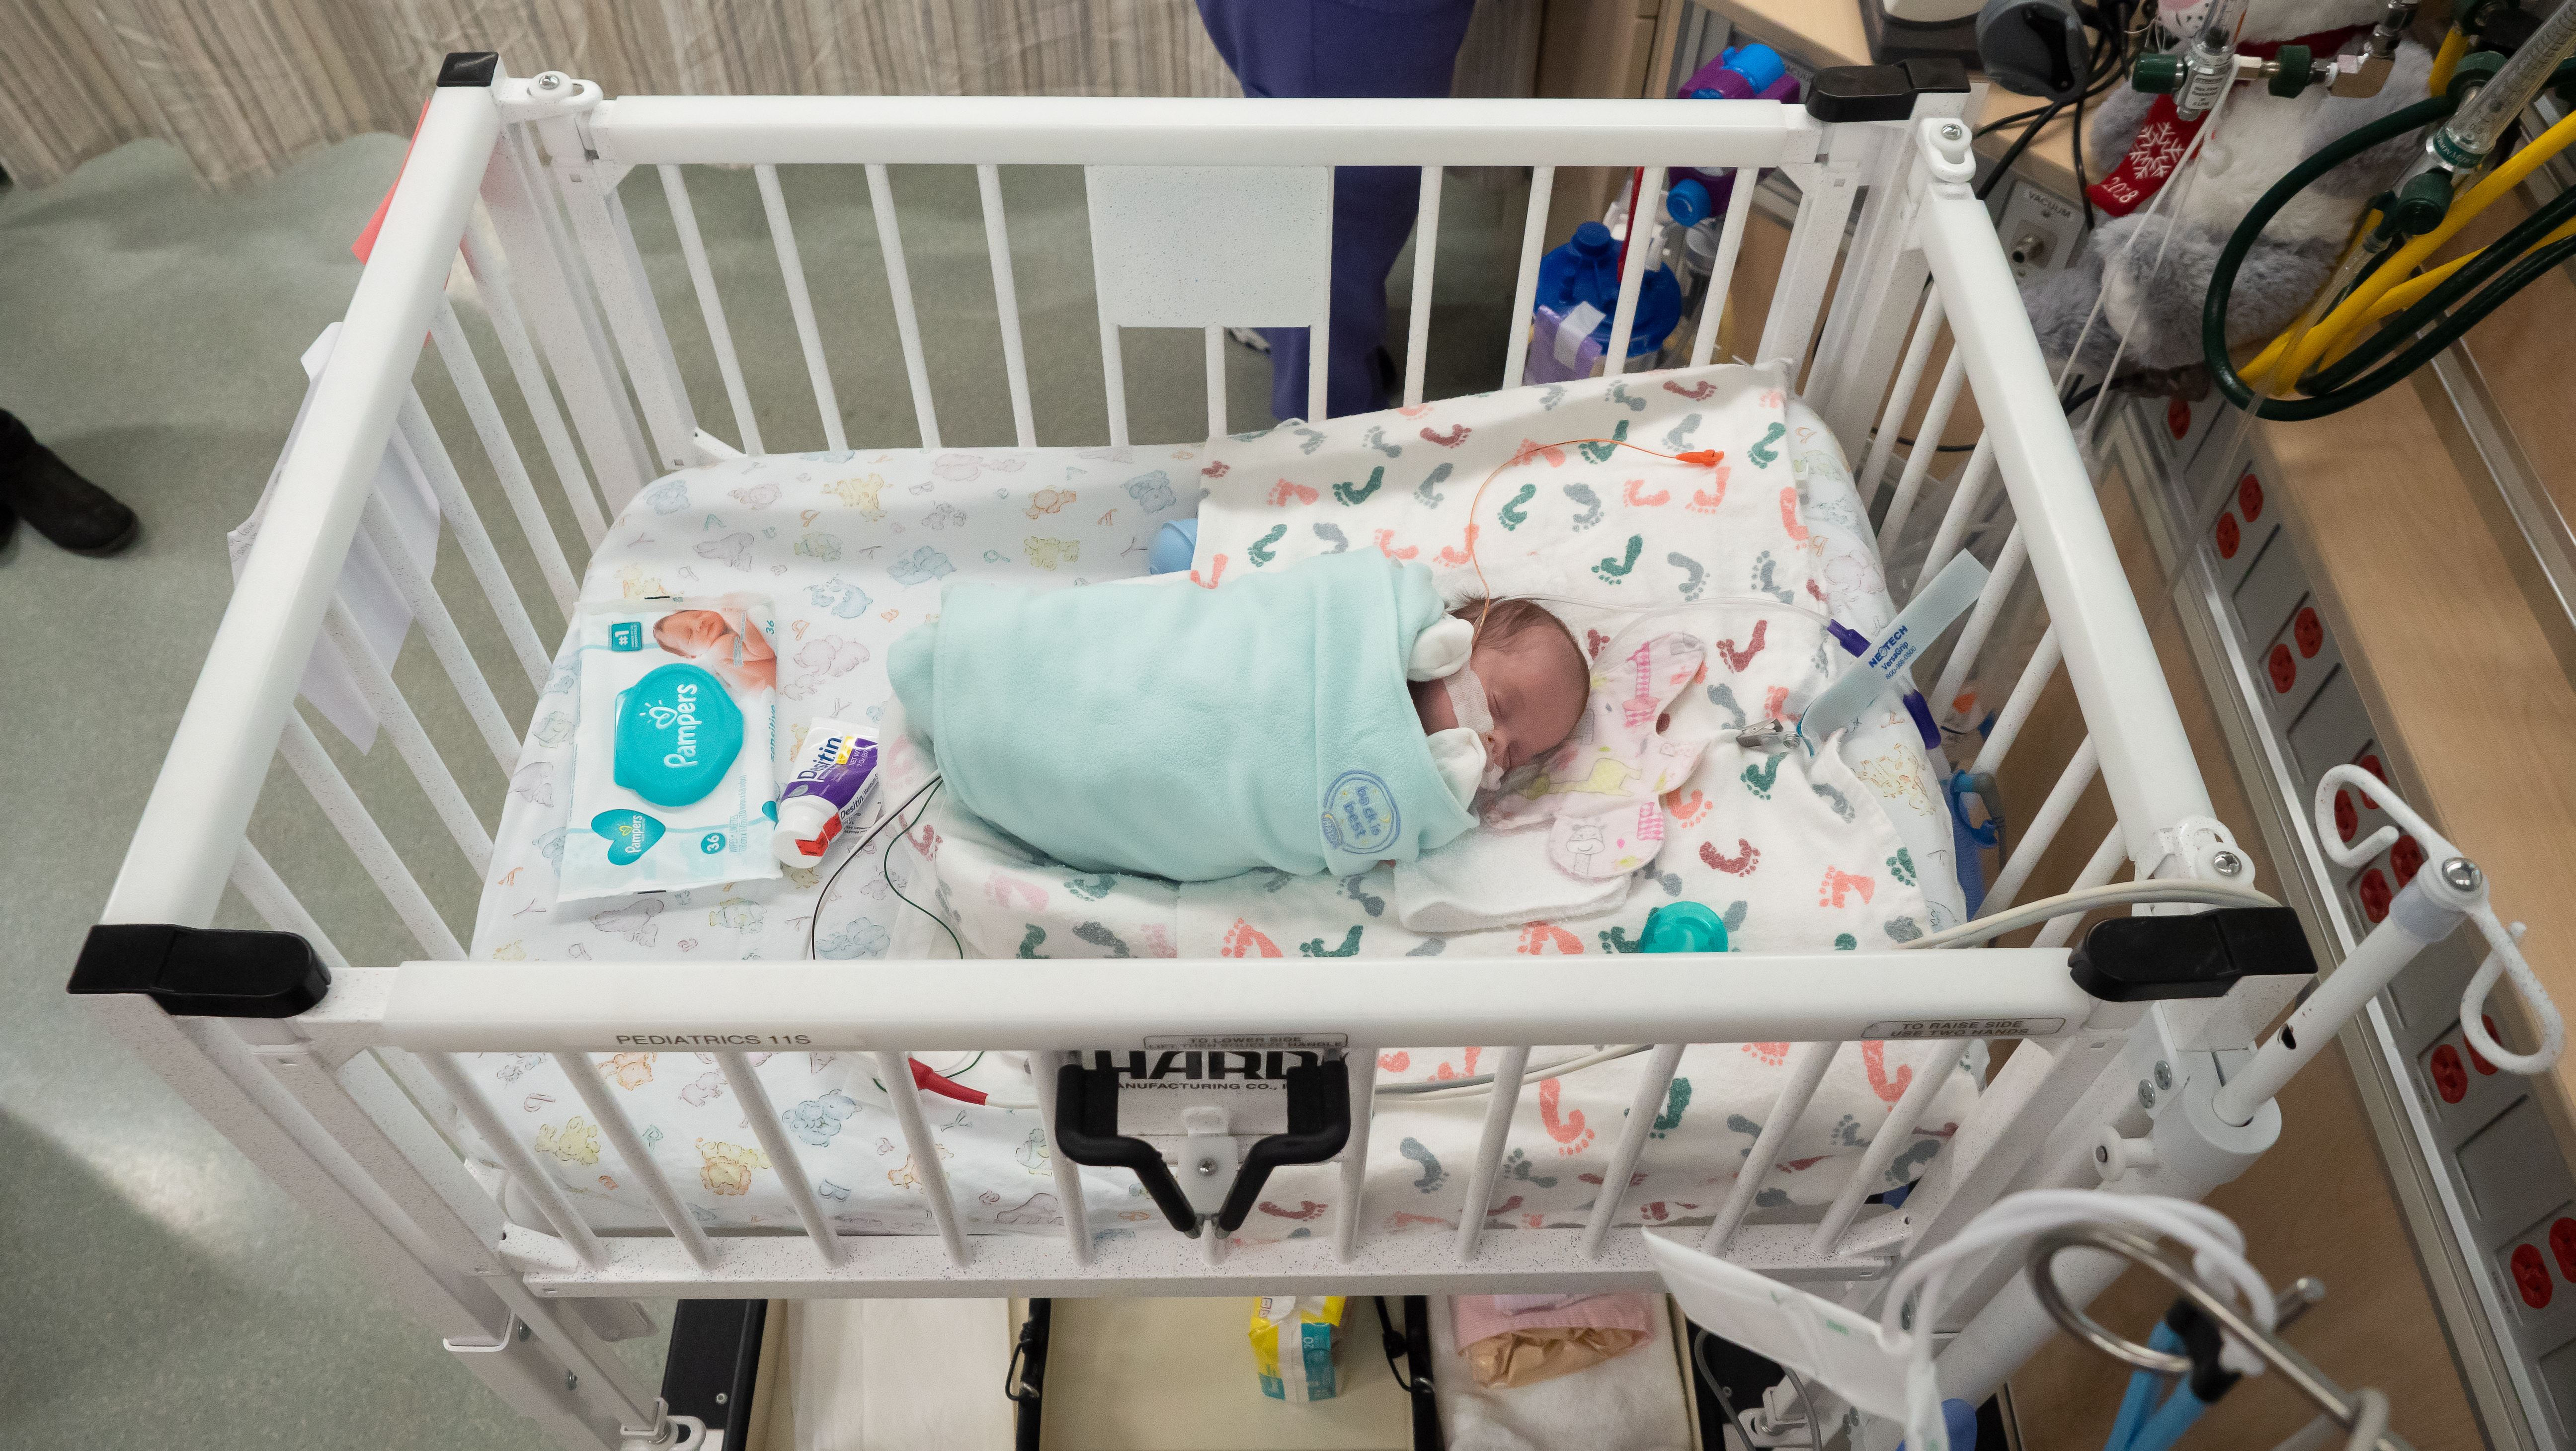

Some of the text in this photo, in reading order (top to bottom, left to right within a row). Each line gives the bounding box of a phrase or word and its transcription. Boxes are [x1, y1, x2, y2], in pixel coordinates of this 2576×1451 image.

[2028, 190, 2071, 218] VACUUM
[614, 630, 630, 645] #1
[766, 620, 775, 635] 36
[1881, 642, 1909, 670] VersaGrip
[663, 683, 699, 769] Pampers
[797, 737, 842, 780] Desitin
[840, 795, 864, 820] Desitin
[1343, 801, 1367, 839] best
[625, 815, 644, 854] Pampers
[707, 835, 720, 851] 36
[616, 1035, 812, 1045] PEDIATRICS 11S
[1095, 1050, 1318, 1080] HARD
[1246, 1082, 1278, 1091] CO.,
